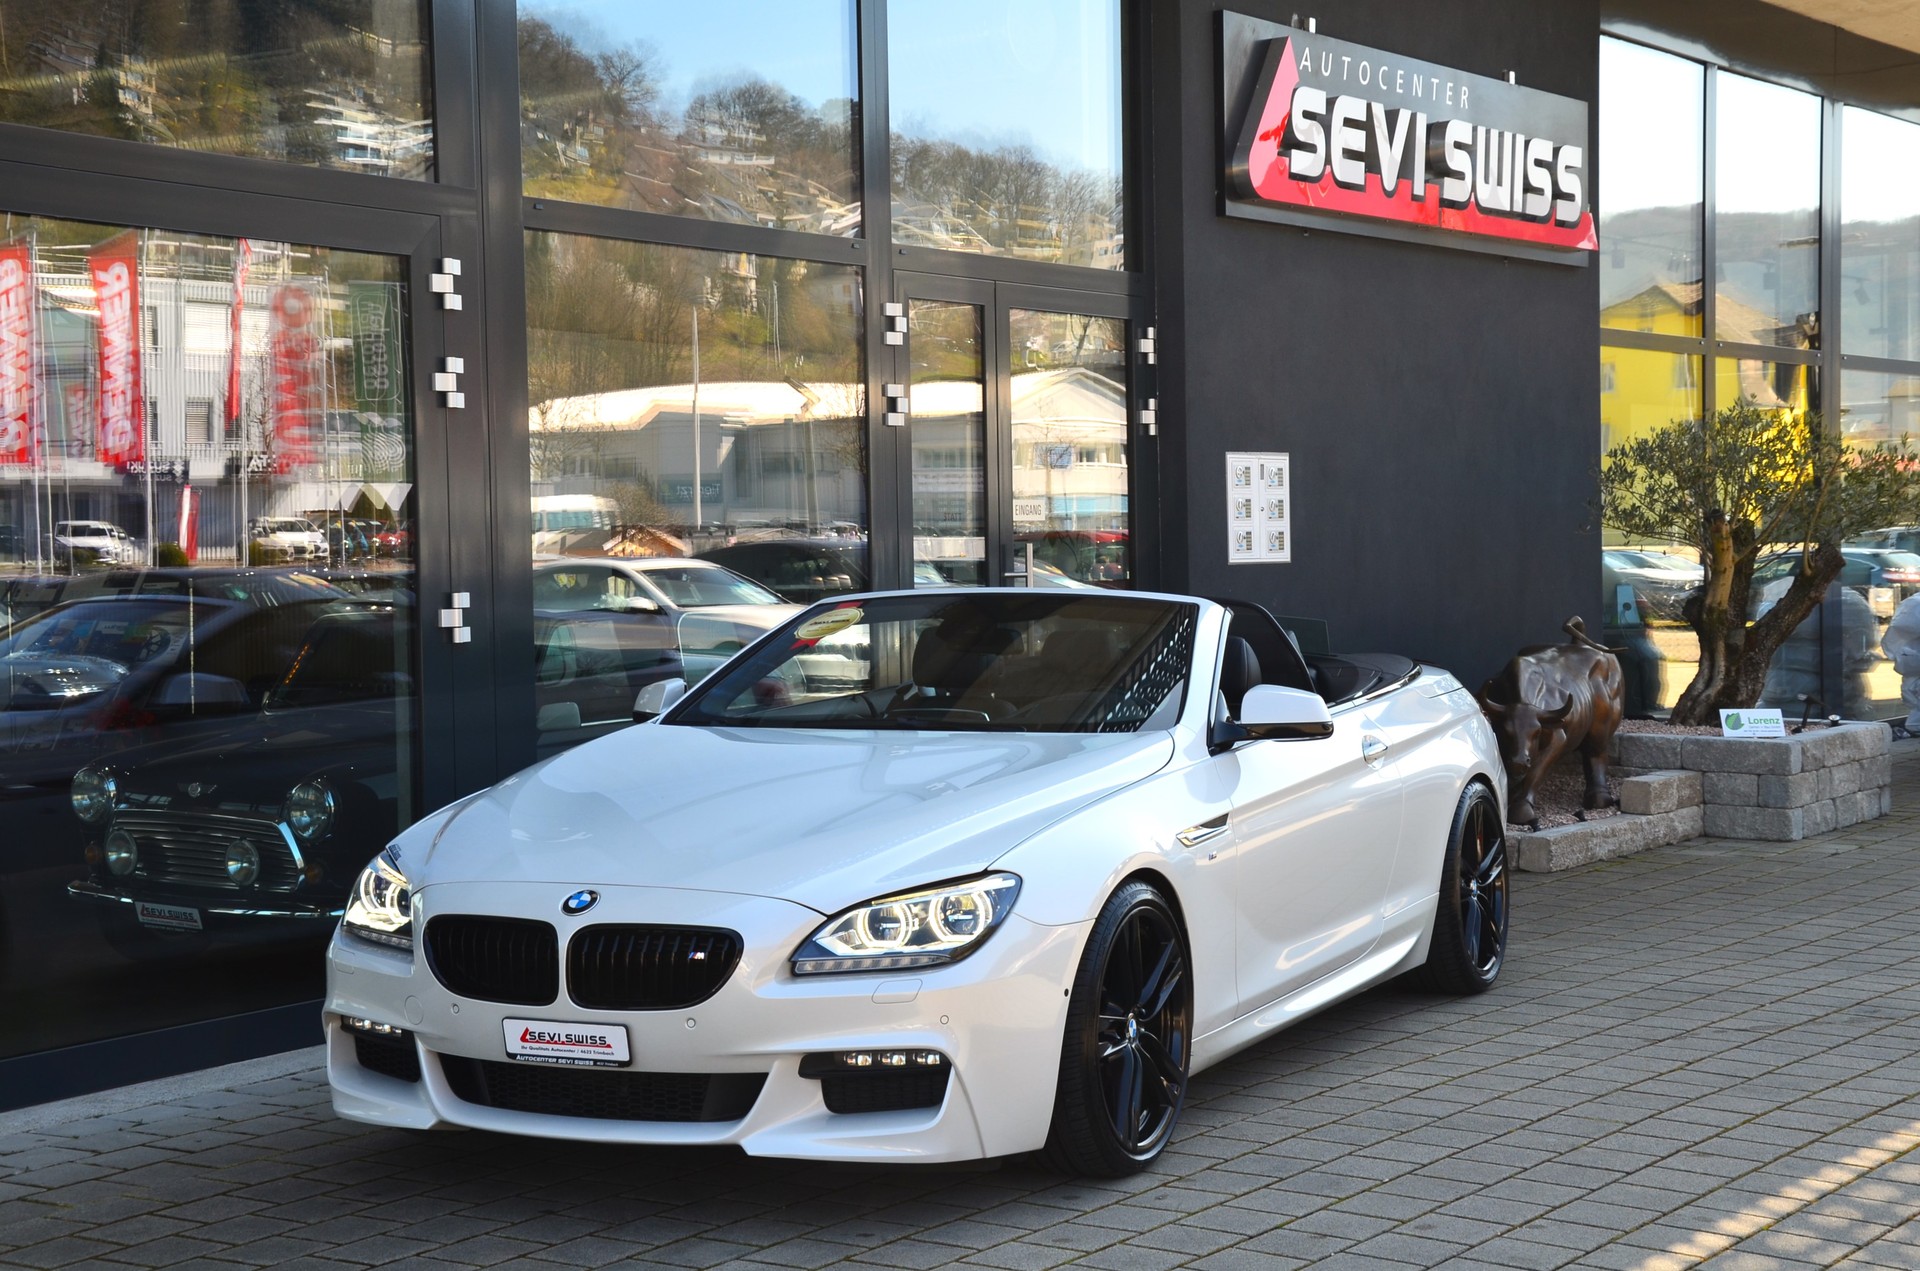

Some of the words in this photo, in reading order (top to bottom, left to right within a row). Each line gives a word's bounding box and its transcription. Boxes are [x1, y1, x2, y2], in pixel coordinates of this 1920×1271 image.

[1300, 47, 1470, 109] AUTOCENTER
[1289, 86, 1427, 197] SEVI
[1443, 119, 1583, 222] SWISS
[1015, 504, 1042, 516] EINGANG
[145, 907, 166, 916] SEVI
[168, 910, 194, 920] SWISS
[528, 1031, 561, 1043] SEVI
[565, 1034, 607, 1045] SWISS
